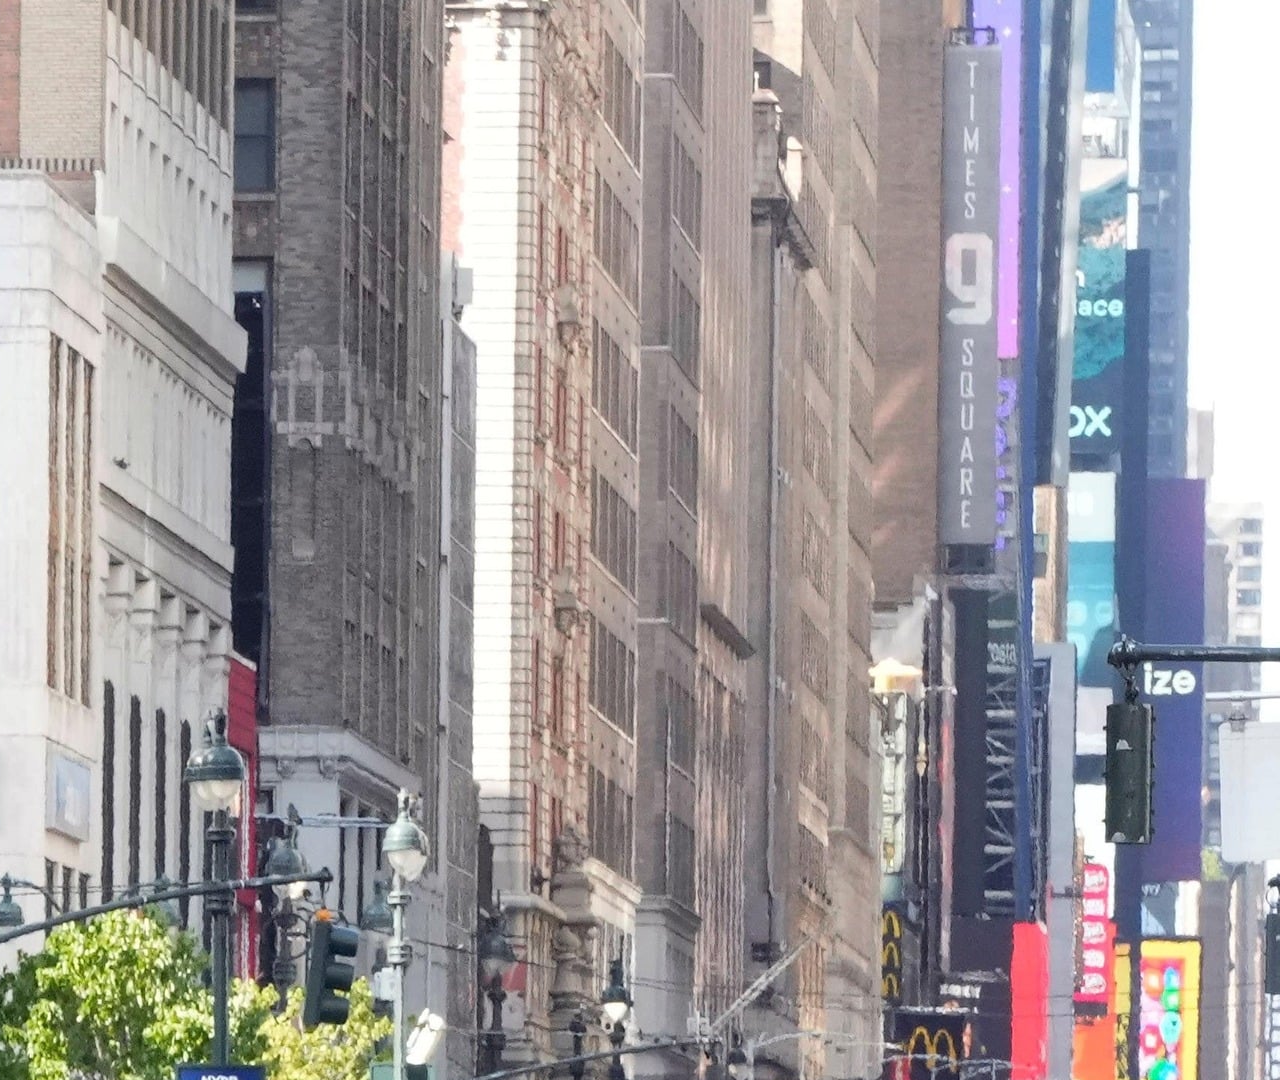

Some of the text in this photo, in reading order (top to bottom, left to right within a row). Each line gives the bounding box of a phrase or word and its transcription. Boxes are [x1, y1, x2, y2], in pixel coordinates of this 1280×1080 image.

[963, 61, 980, 219] TIMES
[945, 232, 993, 325] 9
[1075, 299, 1124, 317] ace
[960, 338, 974, 528] SQUARE
